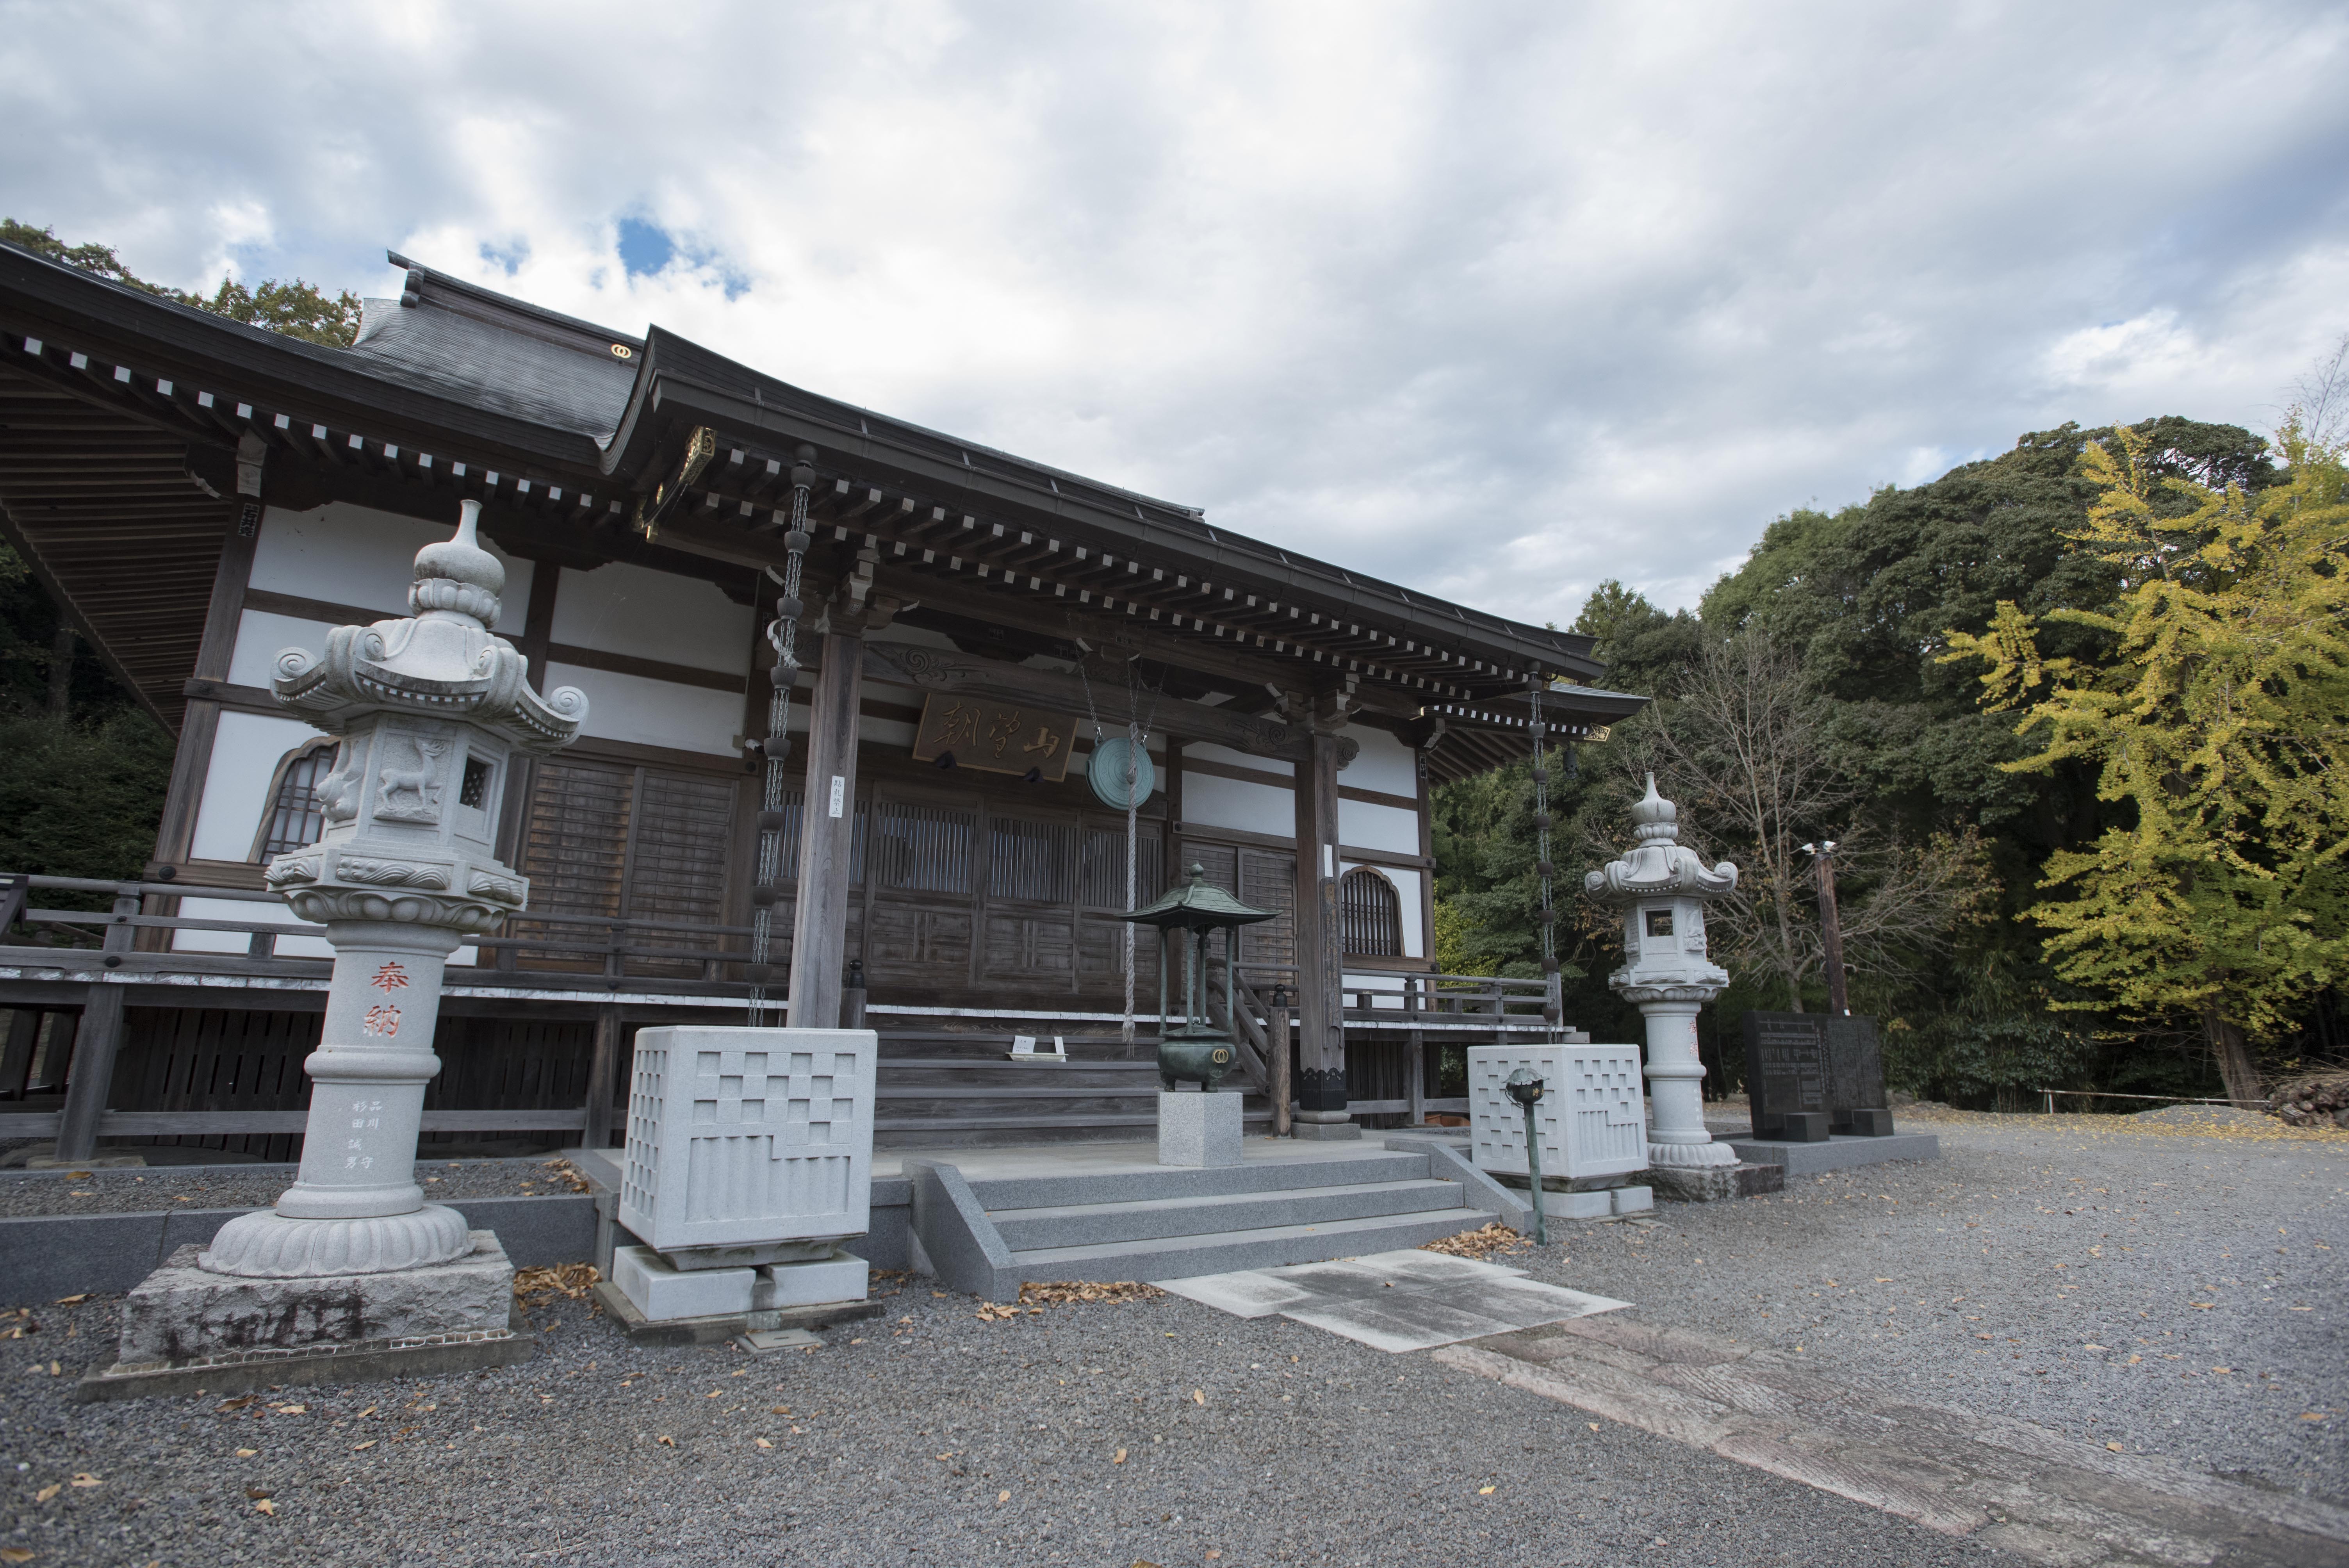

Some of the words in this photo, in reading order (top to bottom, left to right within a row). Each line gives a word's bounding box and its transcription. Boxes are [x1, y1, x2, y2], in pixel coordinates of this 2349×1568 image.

[832, 780, 842, 815] 貼札禁止
[363, 961, 409, 1038] 奉納
[344, 1100, 368, 1169] 杉田誠男
